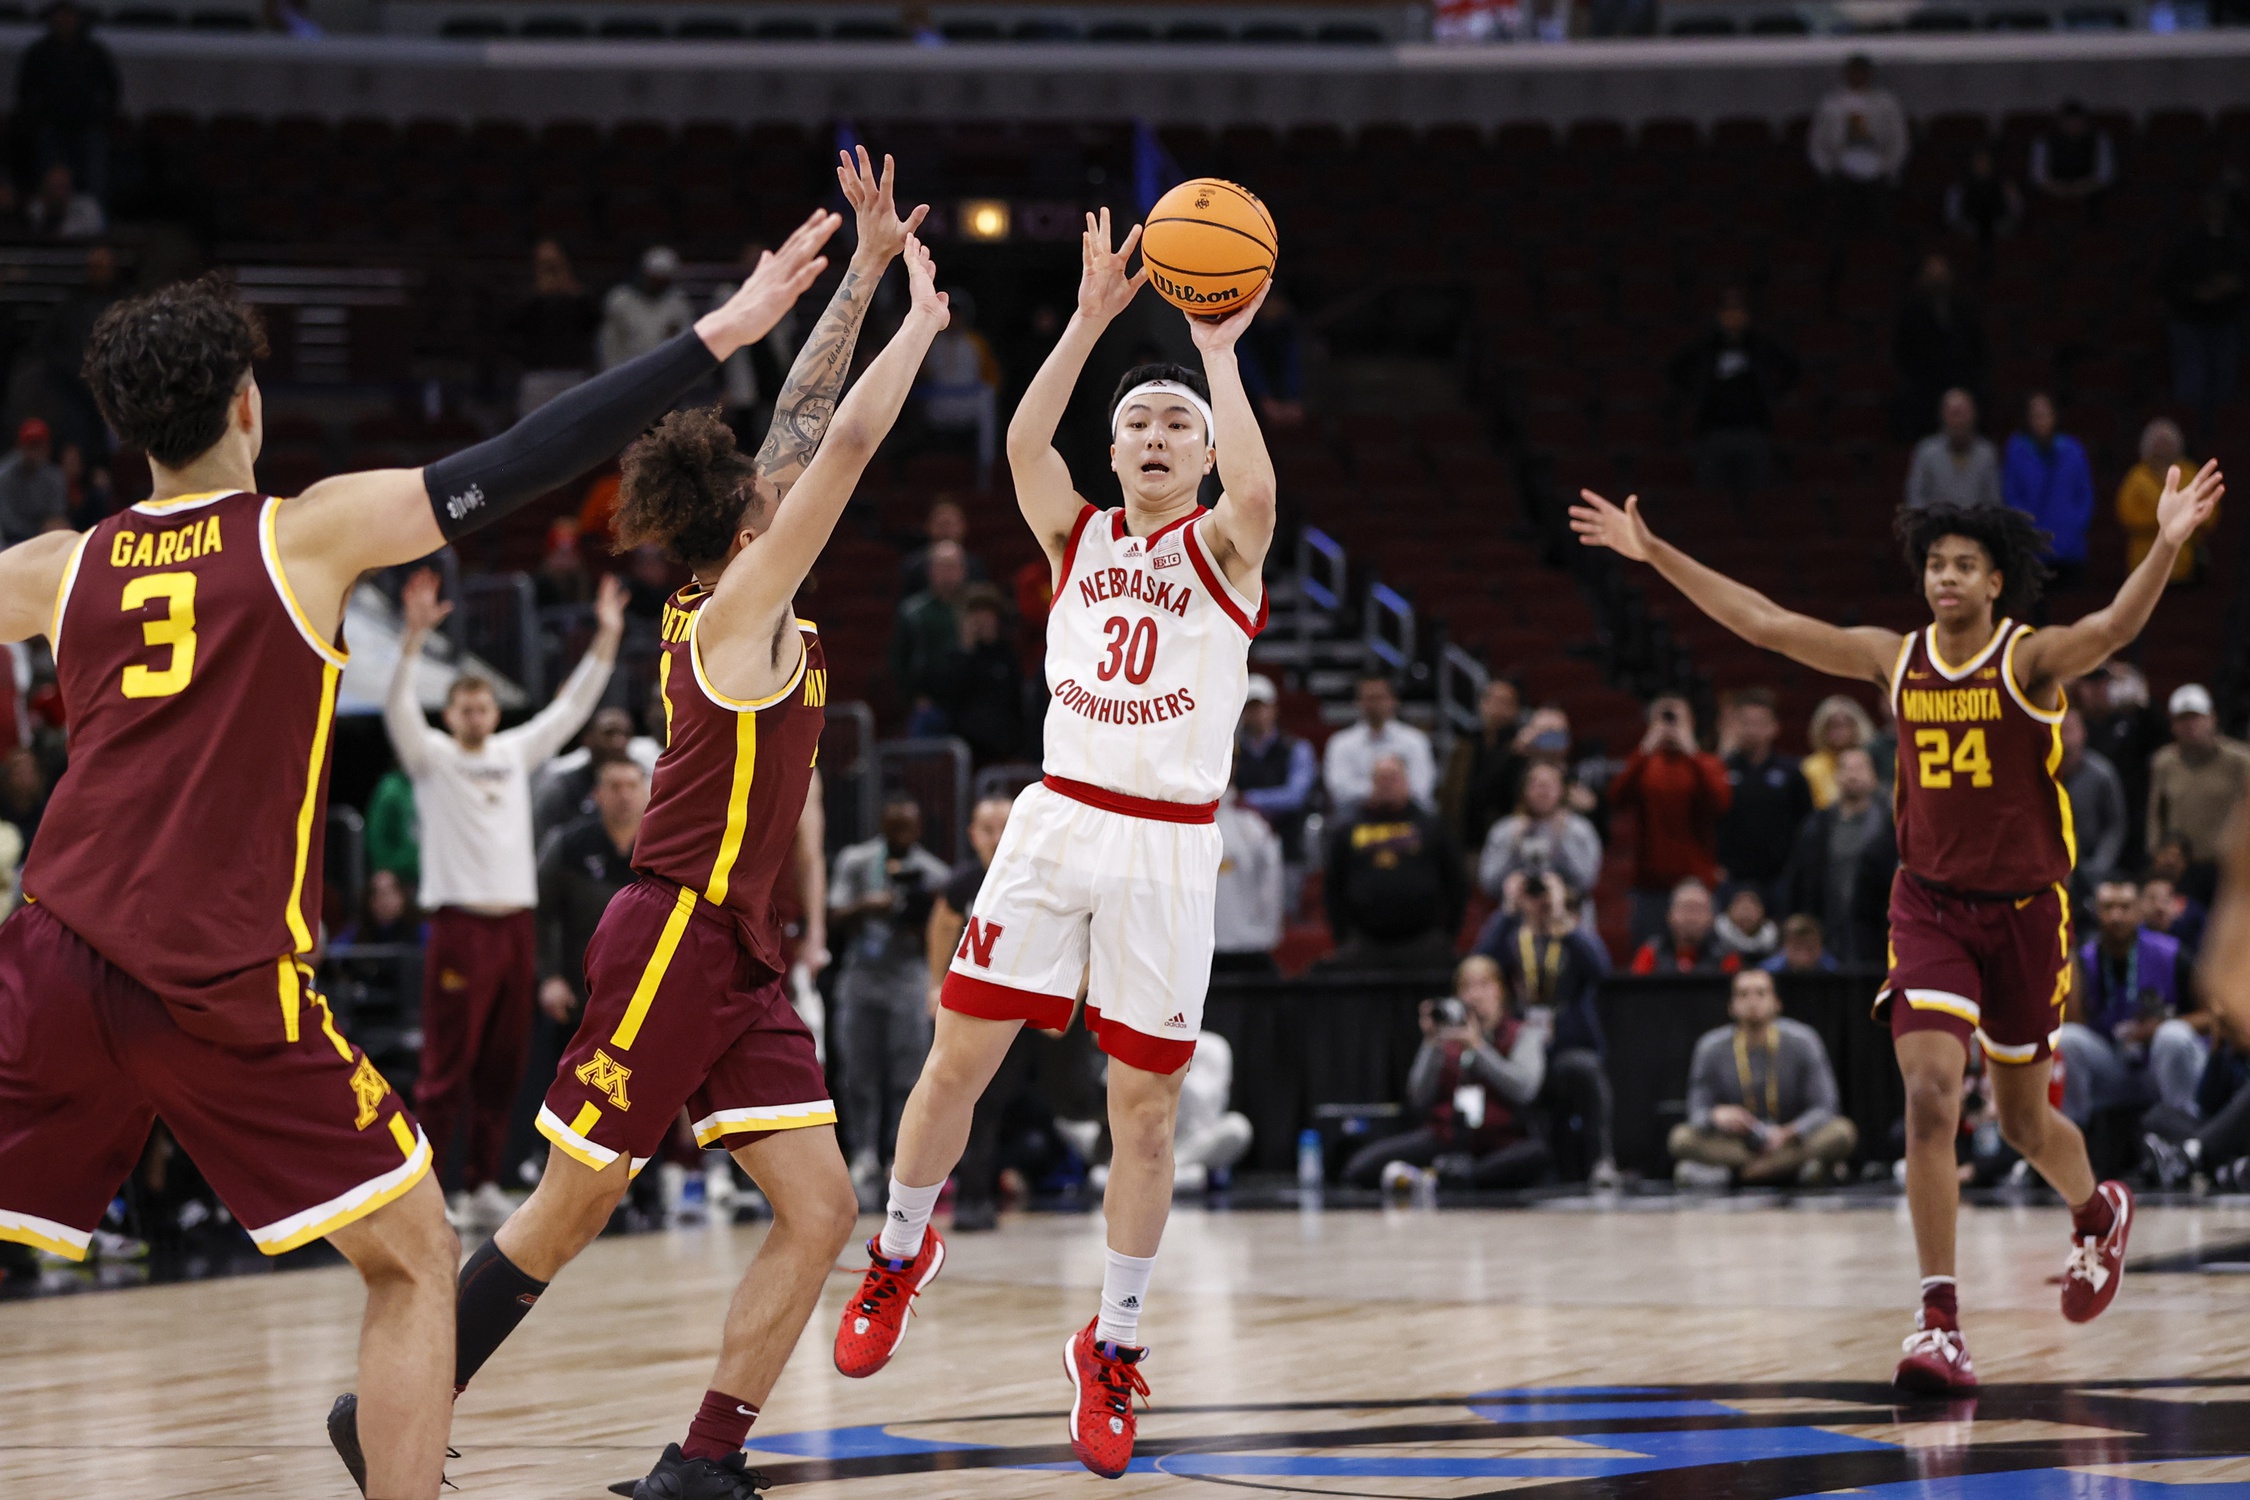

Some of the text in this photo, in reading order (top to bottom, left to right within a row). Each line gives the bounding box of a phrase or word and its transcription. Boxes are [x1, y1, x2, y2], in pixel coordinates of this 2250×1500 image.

[1152, 268, 1239, 304] Wilson
[110, 515, 223, 568] GARCIA
[1078, 567, 1192, 618] NEBRASKA
[121, 571, 198, 699] 3
[1097, 616, 1158, 685] 30
[1054, 678, 1195, 725] CORNHUSKERS
[1902, 687, 2002, 722] MINNESOTA
[1914, 727, 1993, 789] 24
[957, 914, 1005, 971] N
[575, 1048, 632, 1112] M
